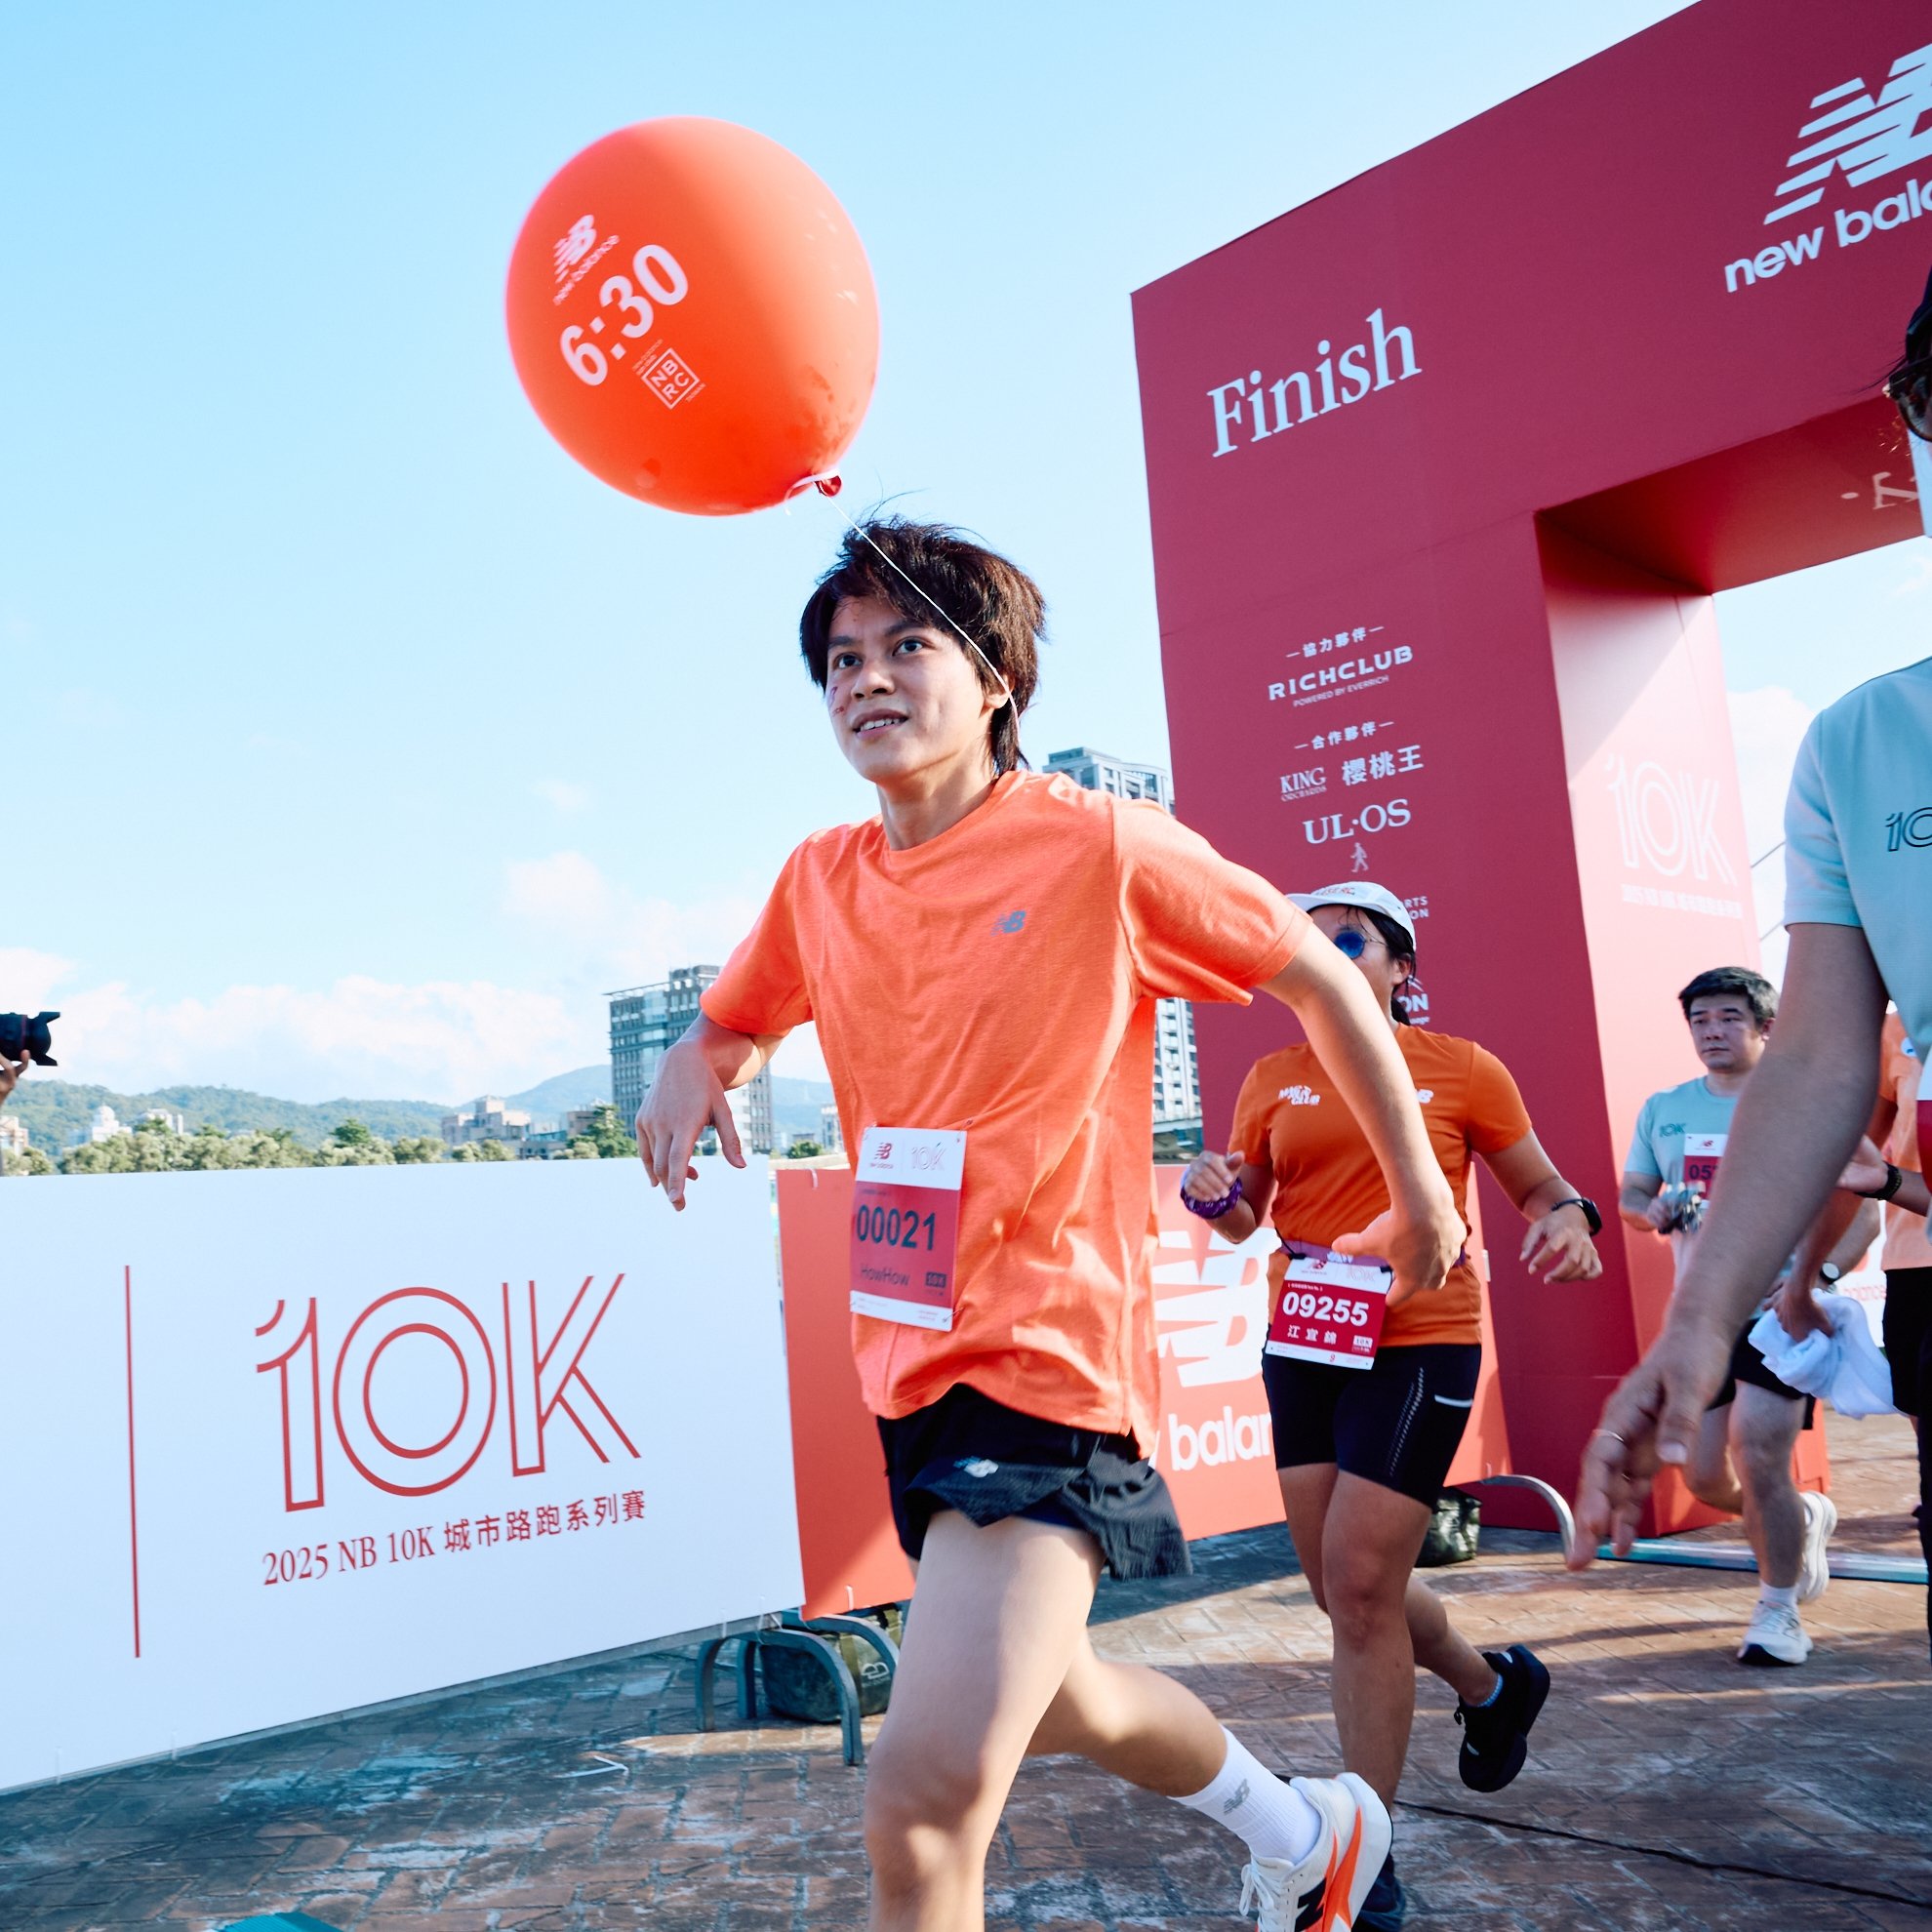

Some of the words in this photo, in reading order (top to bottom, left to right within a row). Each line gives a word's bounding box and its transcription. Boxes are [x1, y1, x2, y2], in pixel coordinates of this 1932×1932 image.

[1724, 226, 1824, 293] new
[559, 244, 689, 385] 6:30
[1206, 307, 1423, 458] Finish
[1268, 644, 1414, 701] RICHCLUB
[1293, 690, 1334, 707] POWERED
[1334, 687, 1346, 697] BY
[1348, 674, 1389, 693] EVERRICH
[1279, 766, 1327, 794] KING
[1342, 745, 1425, 786] 櫻桃王
[1604, 752, 1739, 887] 10K
[856, 1204, 937, 1251] 00021
[1282, 1291, 1370, 1327] 09255
[254, 1272, 642, 1513] 10K
[262, 1544, 329, 1585] 2025
[338, 1535, 378, 1573] NB
[387, 1525, 436, 1564] 10K
[444, 1490, 646, 1553] 城市路跑系列賽
